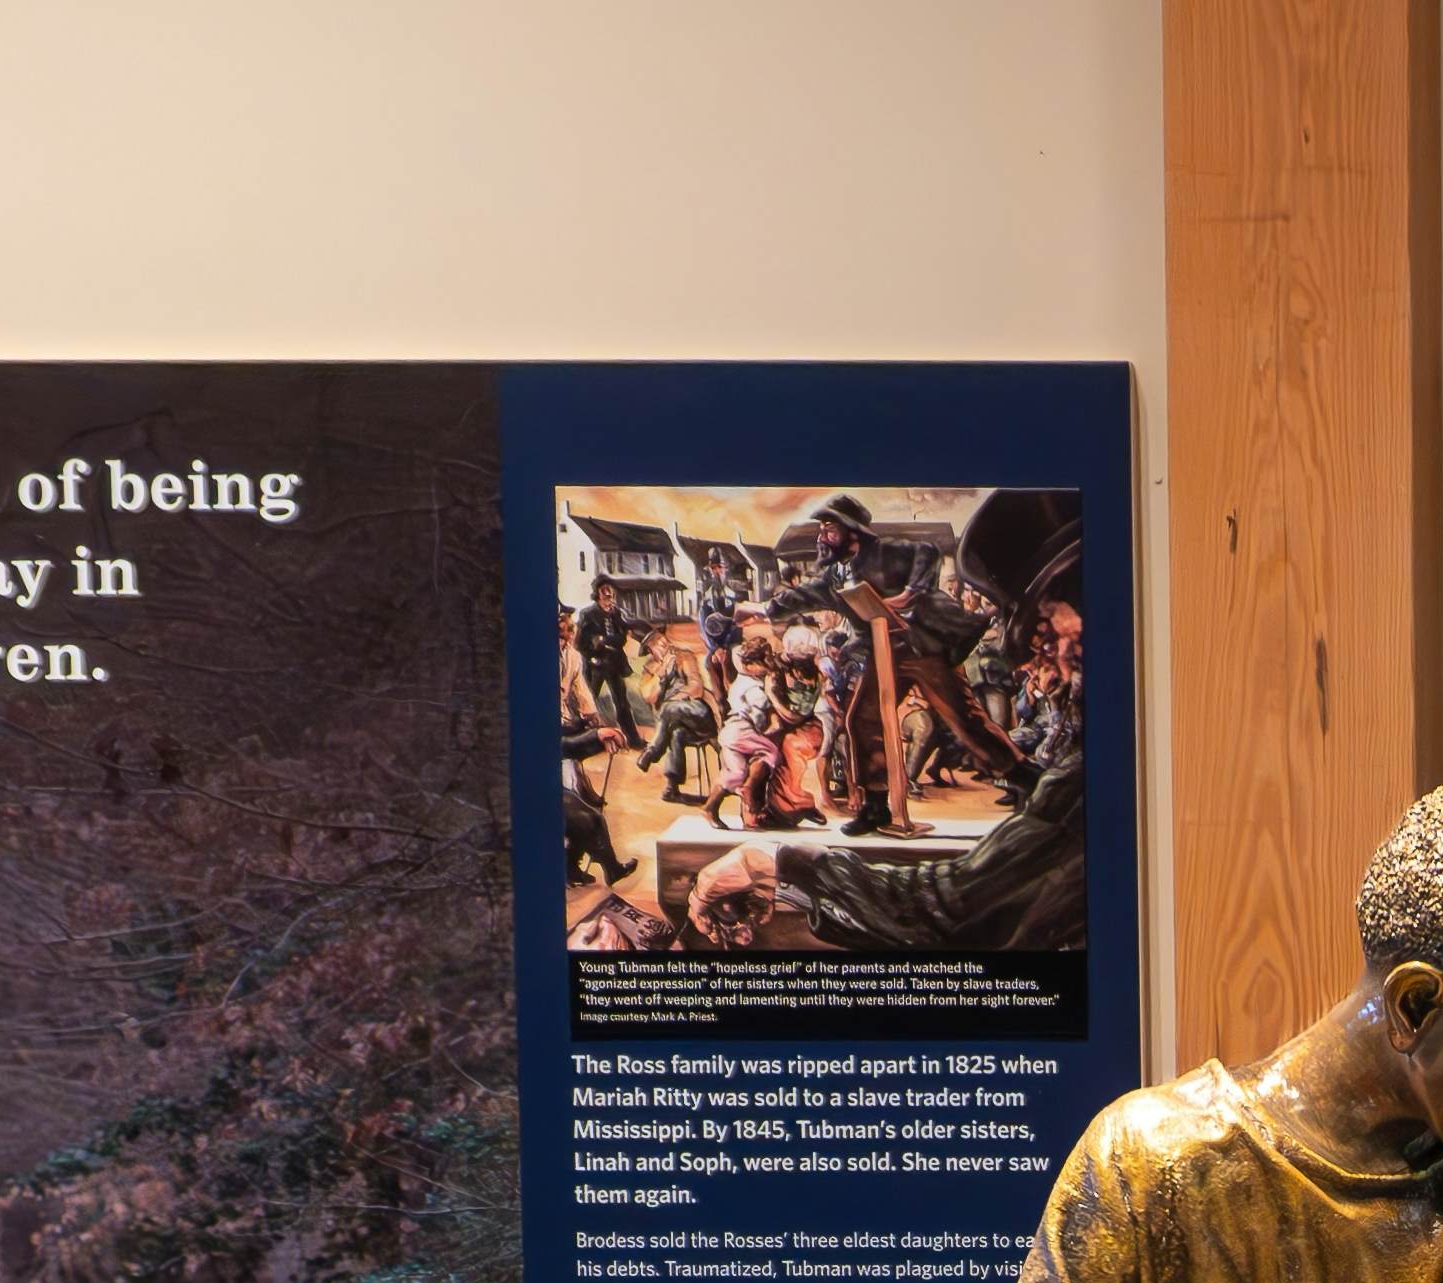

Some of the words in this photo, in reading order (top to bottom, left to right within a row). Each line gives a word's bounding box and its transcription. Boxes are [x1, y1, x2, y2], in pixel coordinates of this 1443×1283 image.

[17, 457, 91, 513] of
[104, 459, 301, 524] being
[71, 545, 141, 597] in
[613, 994, 643, 1006] went
[644, 993, 662, 1006] off
[663, 993, 713, 1008] weeping
[714, 993, 737, 1006] and
[739, 993, 797, 1008] lamenting
[799, 993, 826, 1006] until
[827, 993, 854, 1008] they
[856, 996, 885, 1006] were
[887, 993, 927, 1006] hidden
[929, 993, 957, 1006] from
[959, 993, 979, 1006] her
[981, 994, 1010, 1009] sight
[570, 1054, 612, 1074] The
[617, 1054, 666, 1075] Ross
[670, 1054, 736, 1079] family
[741, 1059, 783, 1075] was
[787, 1054, 855, 1079] ripped
[860, 1055, 917, 1079] apart
[921, 1054, 940, 1075] in
[945, 1055, 996, 1075] 1825
[1001, 1054, 1057, 1075] when
[573, 1119, 697, 1144] Mississippi.
[702, 1119, 728, 1144] By
[732, 1119, 791, 1142] 1845,
[795, 1119, 897, 1139] Tubman’s
[901, 1119, 956, 1140] older
[960, 1119, 1035, 1142] sisters,
[574, 1183, 628, 1204] them
[634, 1184, 697, 1208] again.
[576, 1231, 646, 1249] Brodess
[649, 1231, 686, 1249] sold
[690, 1230, 719, 1249] the
[724, 1231, 788, 1249] Rosses’
[793, 1231, 839, 1249] three
[843, 1231, 896, 1249] eldest
[900, 1231, 988, 1252] daughters
[992, 1233, 1011, 1249] to
